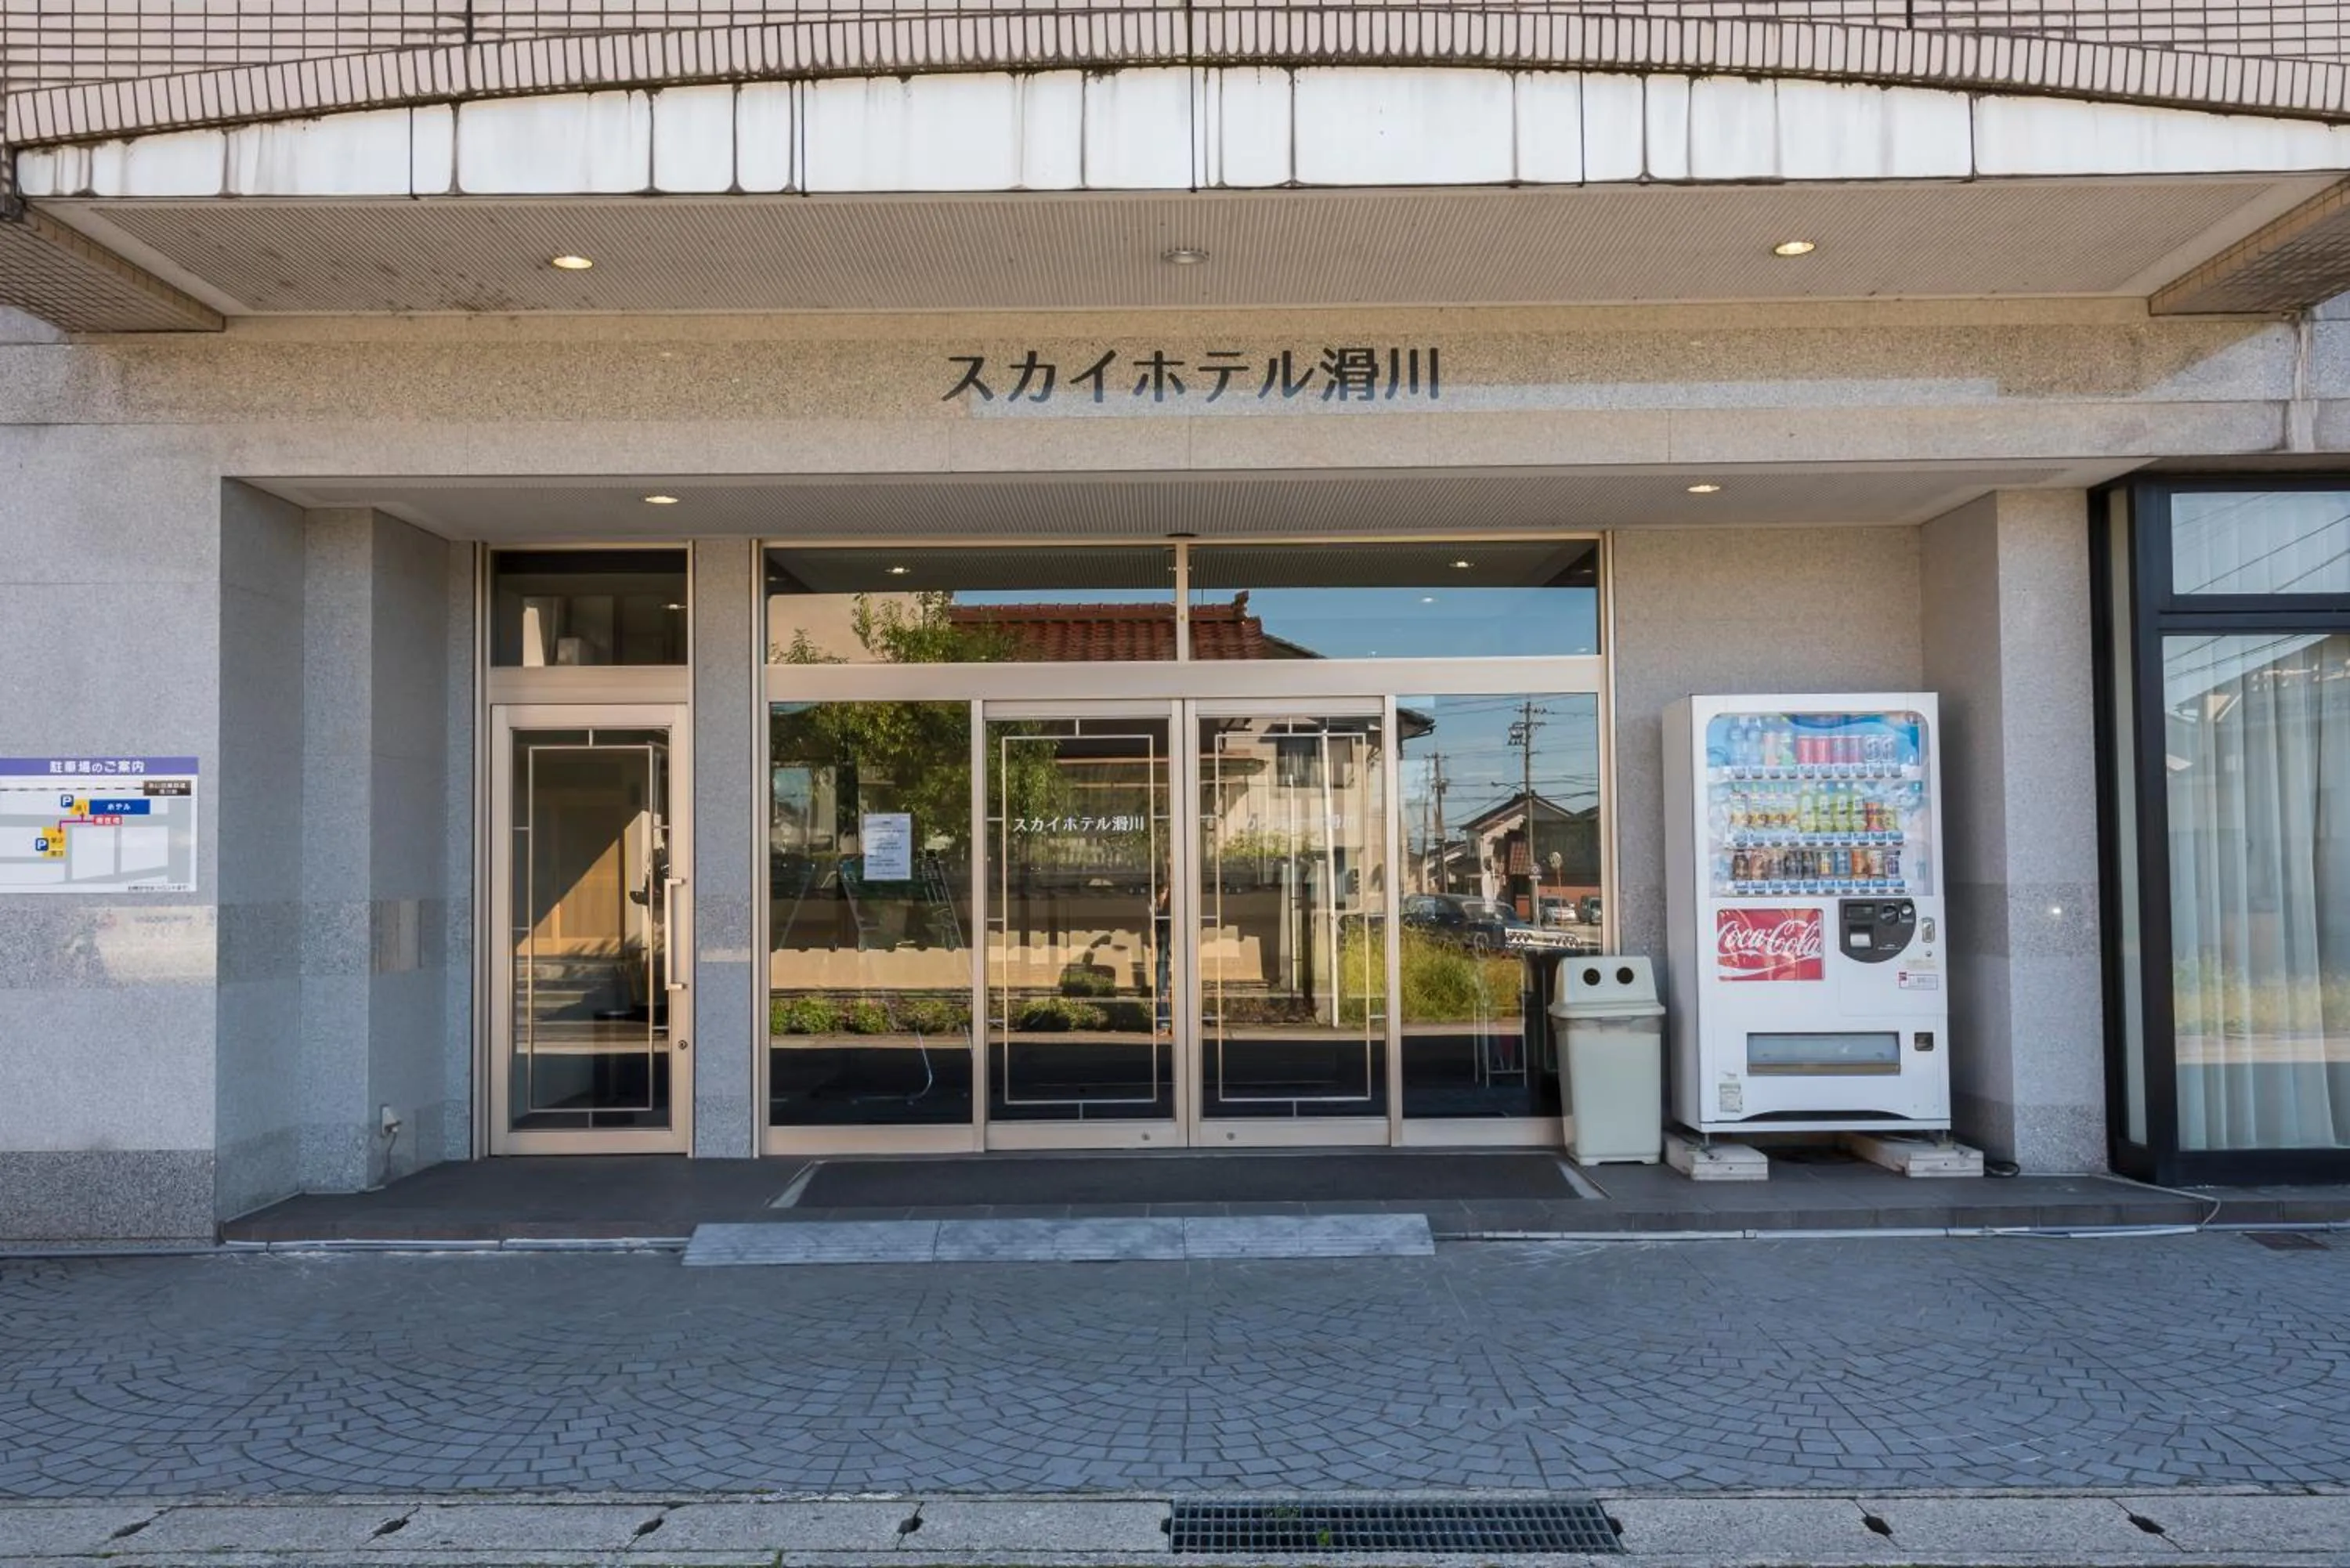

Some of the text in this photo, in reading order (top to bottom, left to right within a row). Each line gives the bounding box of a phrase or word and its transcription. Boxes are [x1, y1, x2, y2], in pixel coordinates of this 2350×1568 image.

[942, 347, 1440, 403] スカイホテル滑川
[49, 761, 145, 774] 駐車場のご案内
[1013, 815, 1144, 833] スカイホテル滑川
[1718, 919, 1822, 957] Coca-Cola
